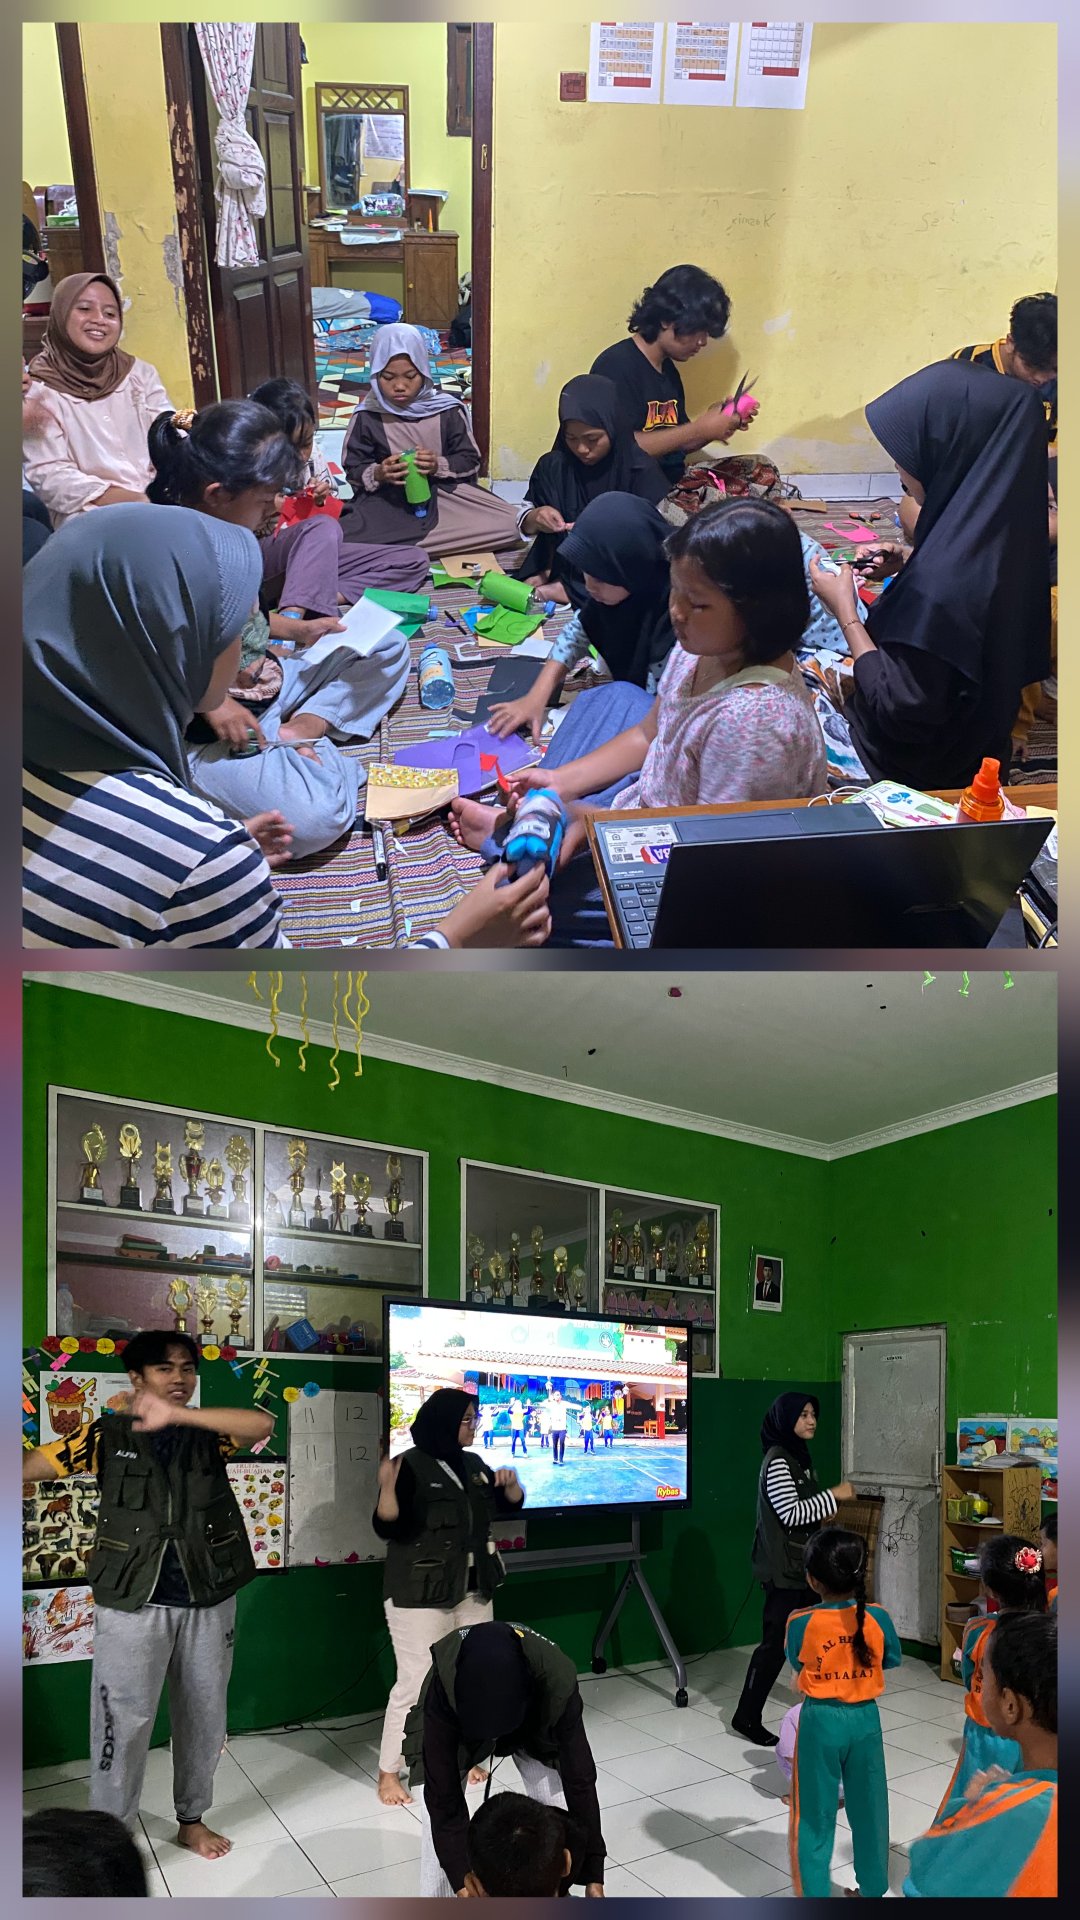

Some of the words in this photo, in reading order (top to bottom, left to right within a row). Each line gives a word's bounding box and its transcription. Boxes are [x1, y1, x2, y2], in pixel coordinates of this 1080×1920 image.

[304, 1407, 315, 1423] 11
[346, 1406, 369, 1422] 12
[306, 1445, 317, 1461] 11
[349, 1446, 370, 1462] 12
[657, 1487, 679, 1498] Rybas
[822, 1640, 836, 1653] AL
